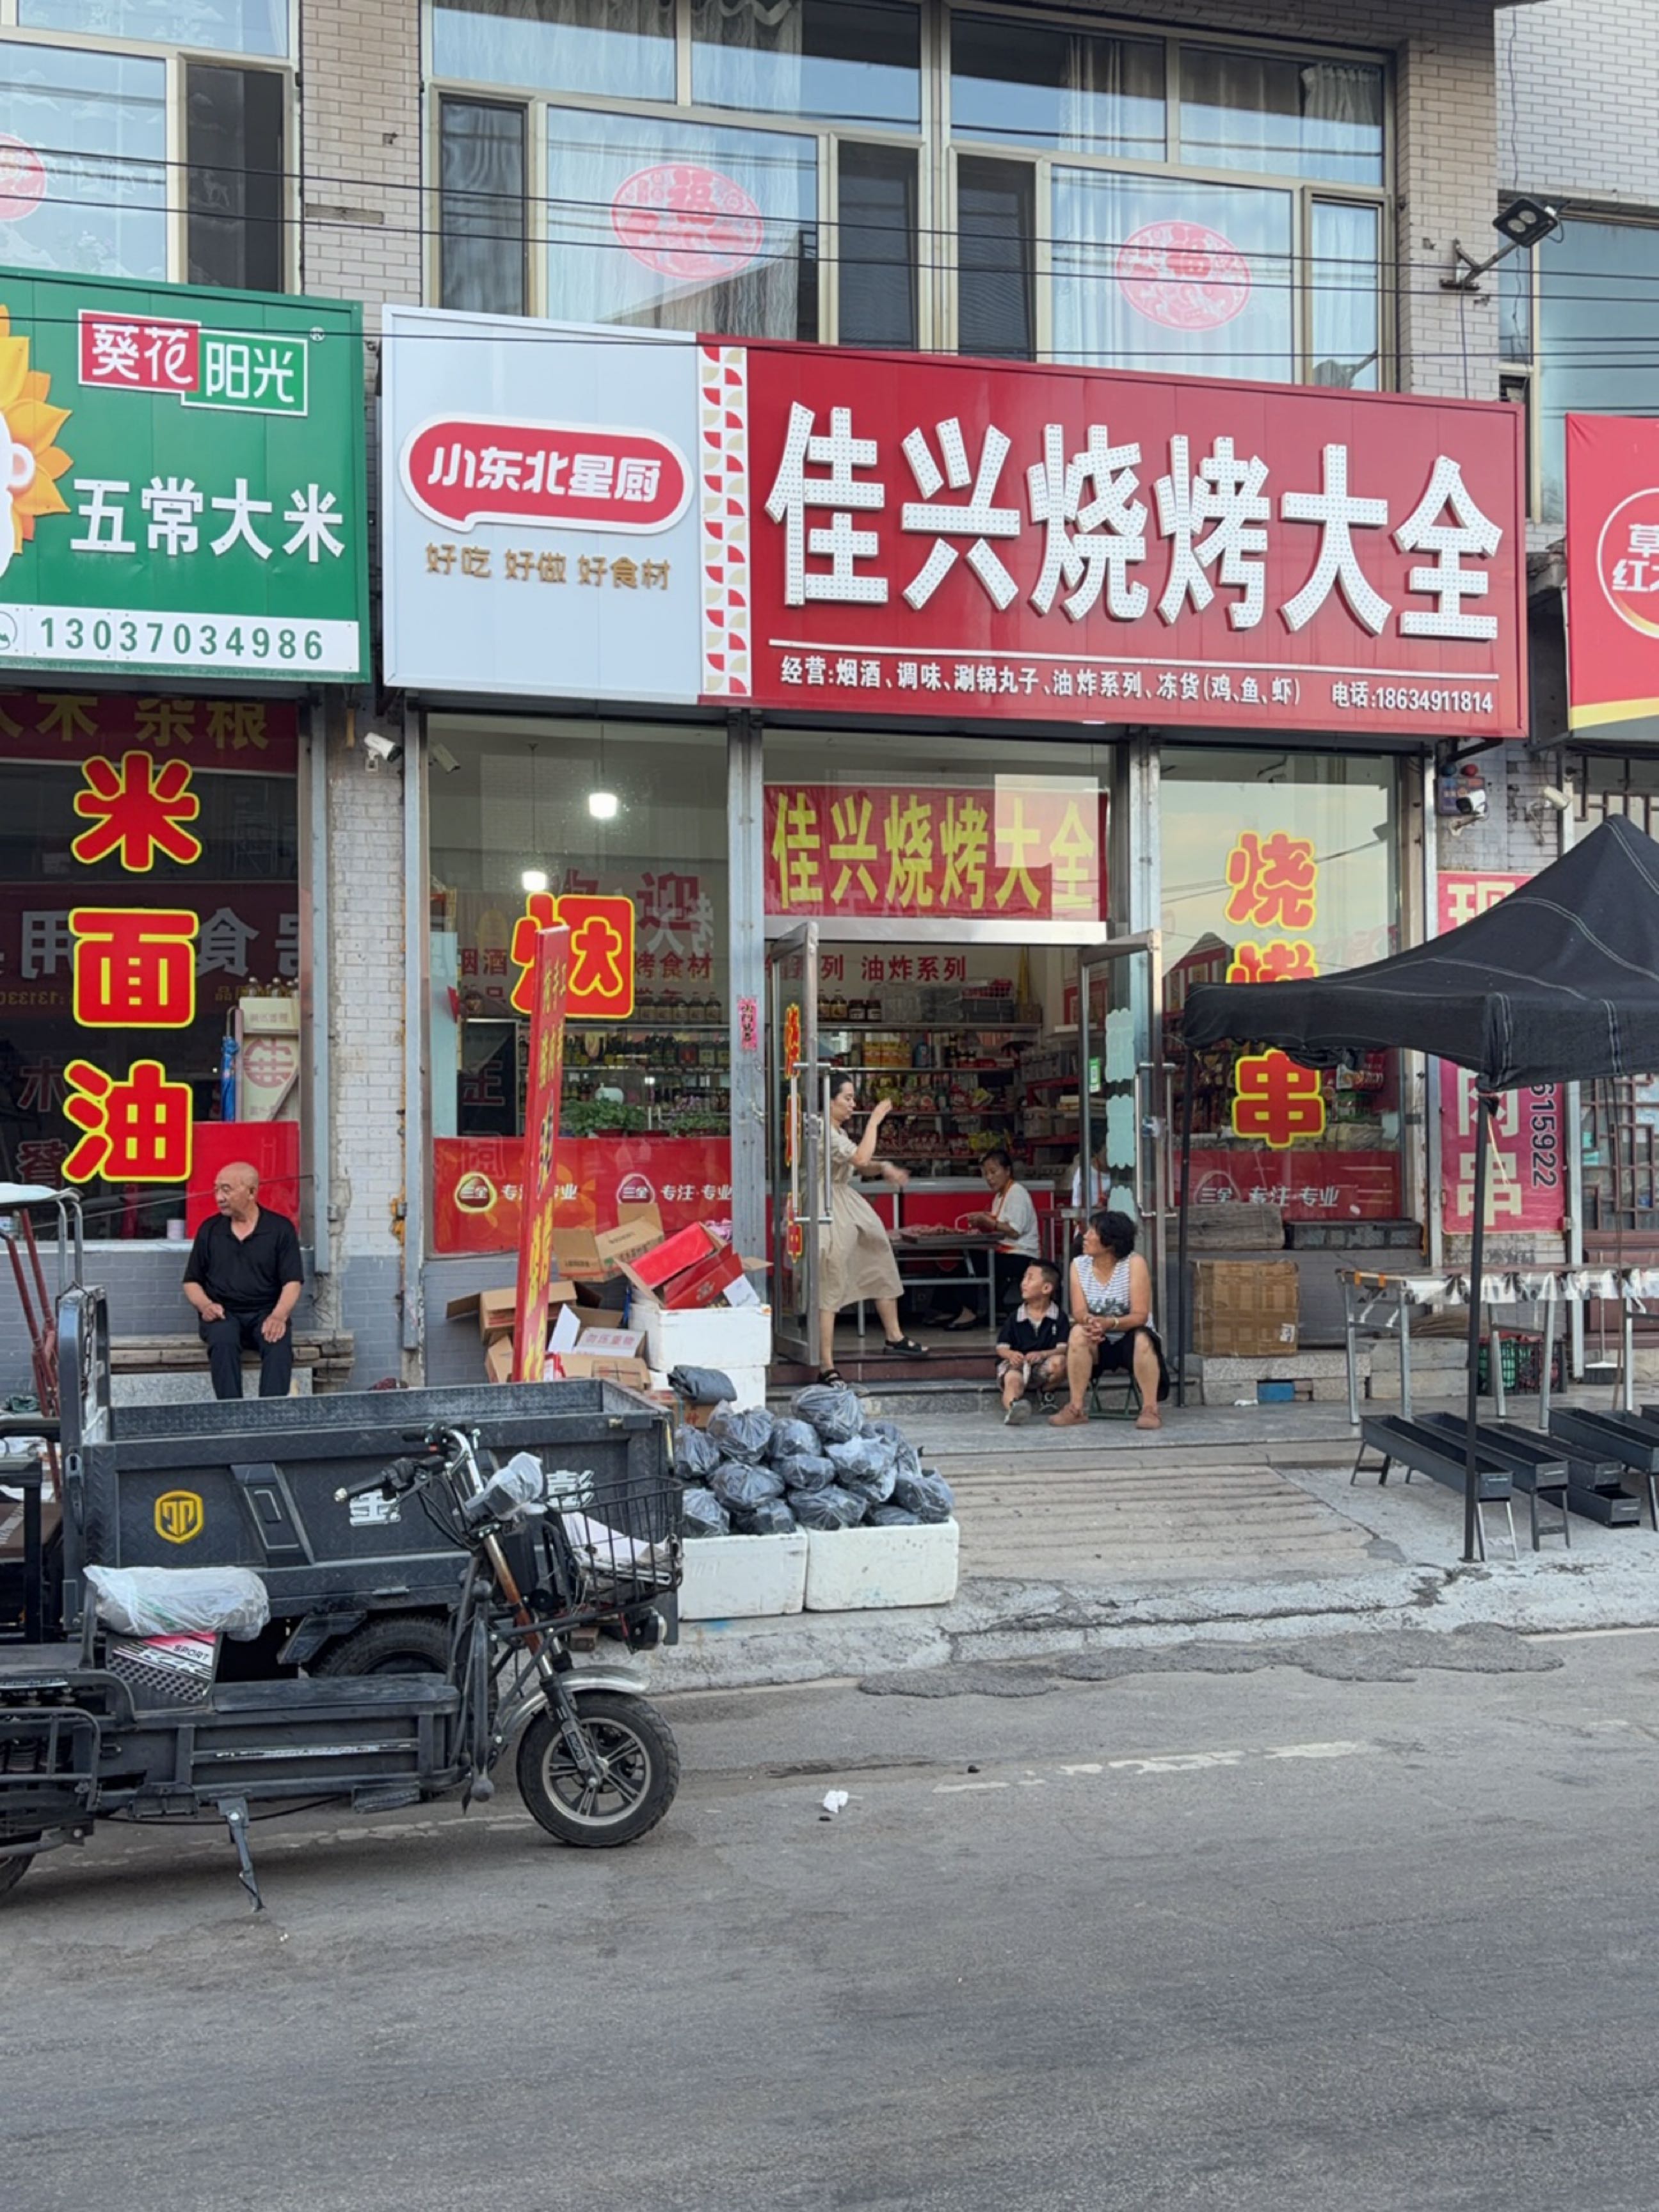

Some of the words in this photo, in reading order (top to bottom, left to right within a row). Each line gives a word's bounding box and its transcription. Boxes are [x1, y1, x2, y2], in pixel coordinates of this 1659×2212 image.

[427, 442, 662, 503] 小东北星厨
[70, 476, 345, 563] 五常大米
[765, 401, 1503, 641] 佳兴烧烤大全
[426, 543, 492, 578] 好吃
[504, 549, 567, 584] 好做
[577, 554, 670, 590] 好食材
[40, 616, 323, 661] 13037034986
[1331, 680, 1494, 714] 电话:18634911814
[772, 792, 1095, 909] 佳兴烧烤大全
[861, 954, 966, 982] 油炸系列
[459, 1185, 488, 1200] 三全
[621, 1185, 649, 1199] 三全
